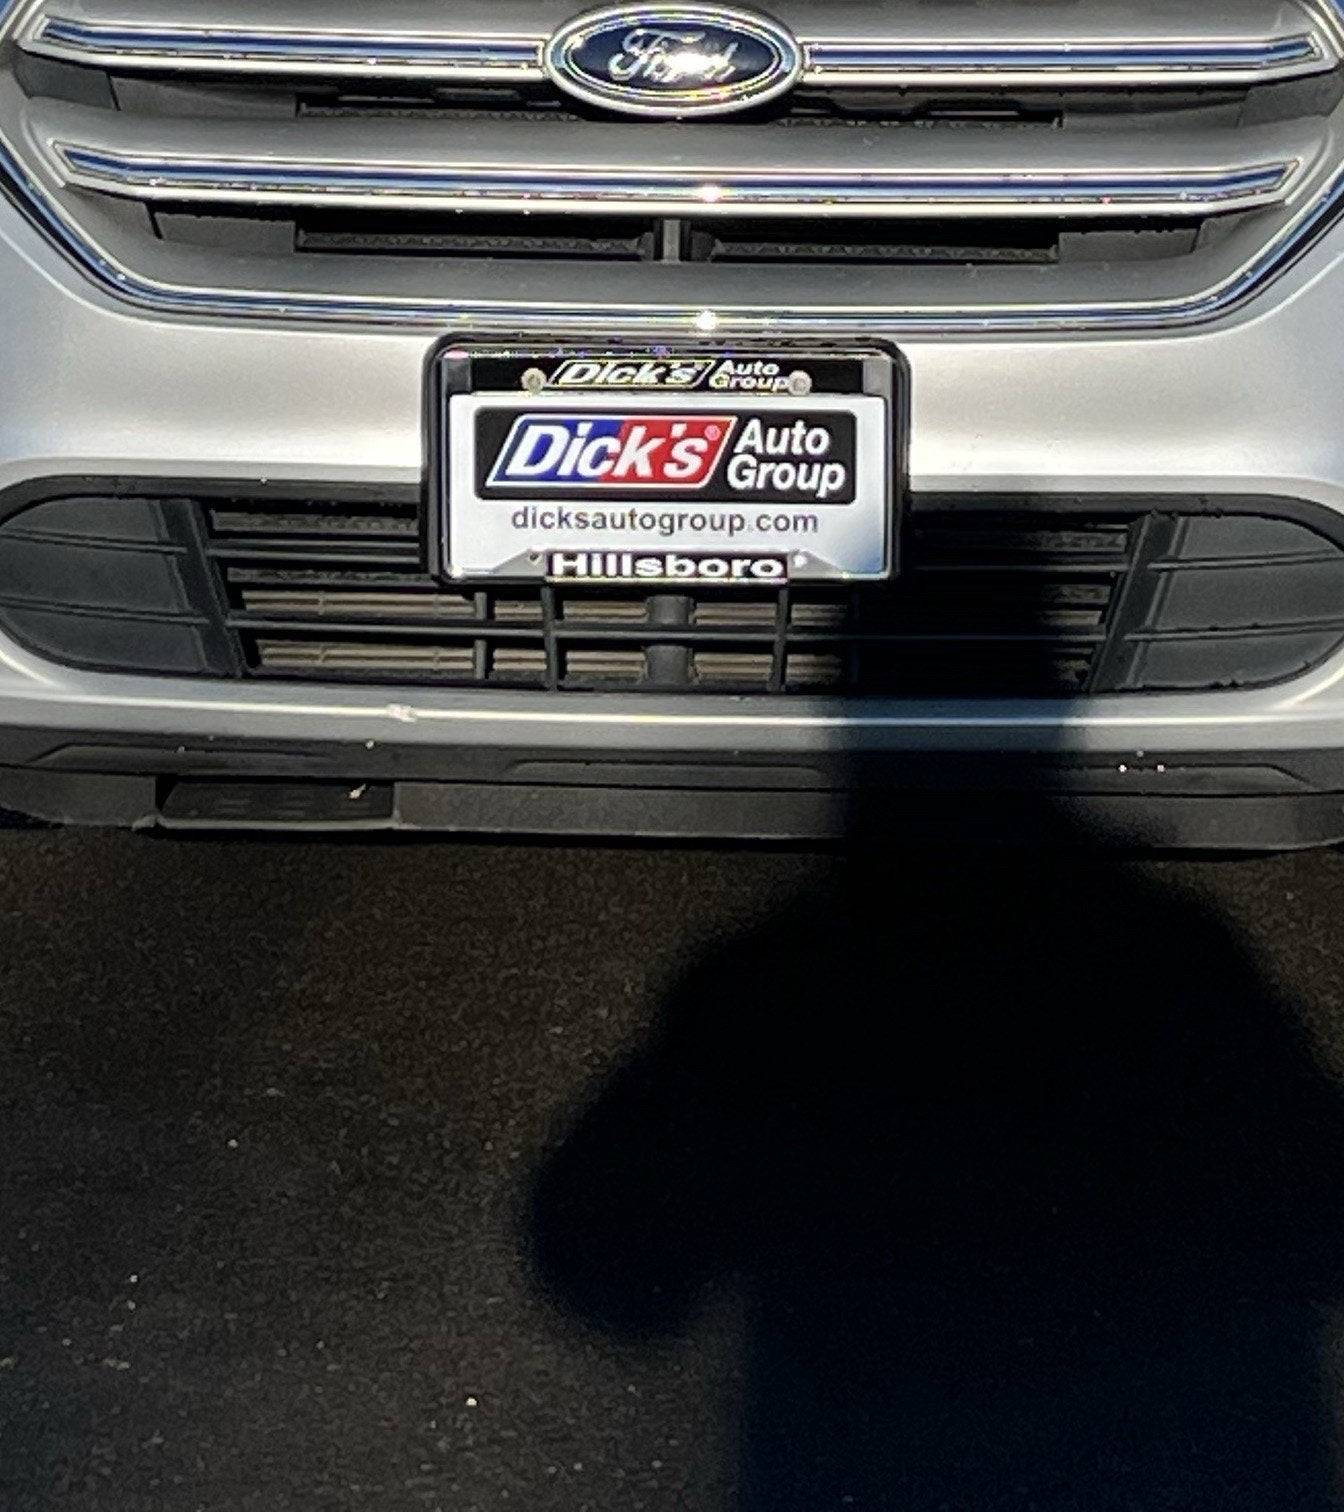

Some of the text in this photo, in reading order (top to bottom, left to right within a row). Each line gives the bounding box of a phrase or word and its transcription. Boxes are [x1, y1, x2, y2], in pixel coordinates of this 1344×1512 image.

[559, 361, 699, 386] Dick's
[719, 359, 780, 376] Auto
[709, 374, 790, 392] Group
[505, 422, 708, 478] Dick's
[734, 419, 830, 455] Auto
[726, 454, 847, 498] Group
[512, 506, 819, 536] dicksautogroup.com
[551, 554, 784, 578] Hillsboro
